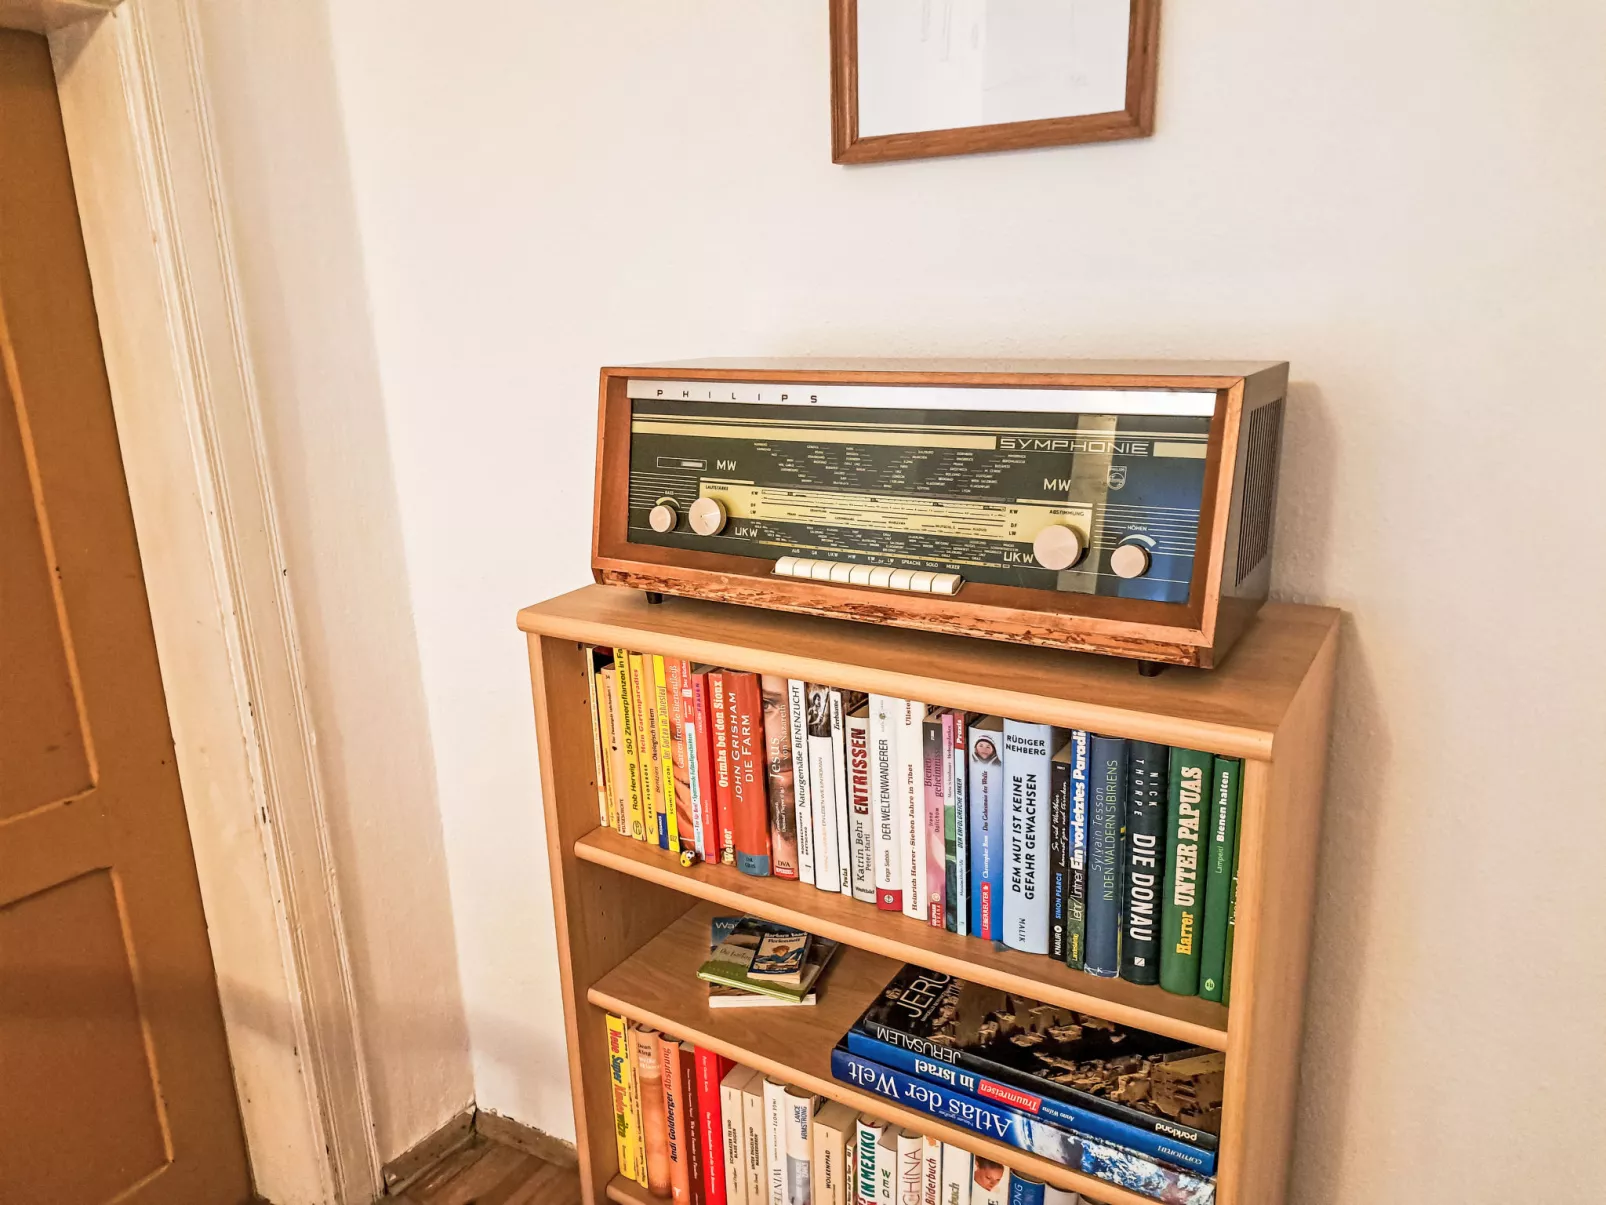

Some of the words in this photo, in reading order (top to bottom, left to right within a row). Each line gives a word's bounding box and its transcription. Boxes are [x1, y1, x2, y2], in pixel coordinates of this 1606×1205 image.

[656, 389, 818, 404] PHILIPS
[1000, 438, 1149, 454] SYMPHONIE
[717, 459, 737, 471] MW
[1043, 478, 1071, 492] MW
[1049, 509, 1085, 517] ABSTIMMUNG
[1127, 523, 1148, 532] HÖHEN
[734, 526, 758, 538] UKW
[1003, 551, 1034, 564] UKW
[619, 670, 632, 736] Zimmerpflanzen
[633, 669, 645, 732] Gartenparadies
[713, 681, 723, 709] Sioux
[714, 712, 725, 730] den
[728, 692, 741, 761] GRISHAM
[778, 704, 787, 741] Nazareth
[791, 686, 802, 749] BIENENZUCHT
[671, 713, 685, 769] Gartenfreude
[716, 731, 726, 748] bei
[741, 714, 752, 756] FARM
[1005, 743, 1046, 756] NEHBERG
[1006, 735, 1045, 747] RÜDIGER
[768, 737, 785, 780] Jesus
[780, 744, 788, 761] von
[628, 763, 636, 792] Herwig
[732, 765, 743, 802] JOHN
[744, 760, 754, 782] DIE
[795, 750, 806, 808] Naturgemäße
[850, 728, 869, 815] ENTRISSEN
[878, 739, 890, 821] WELTENWANDERER
[906, 764, 914, 785] Tibet
[1105, 759, 1117, 813] SIBIRIENS
[1012, 775, 1022, 812] KEINE
[1133, 759, 1145, 816] THORPE
[1148, 772, 1158, 807] NICK
[1218, 771, 1230, 806] halten
[907, 795, 915, 818] Jahre
[1025, 773, 1037, 850] GEWACHSEN
[1072, 781, 1085, 848] vorletztes
[1092, 787, 1103, 826] Tesson
[1176, 766, 1203, 842] PAPUAS
[854, 820, 864, 846] Behr
[881, 823, 892, 841] DER
[908, 820, 916, 847] Sieben
[1012, 814, 1022, 834] IST
[1215, 806, 1226, 843] Bienen
[722, 828, 733, 863] Weiser
[1012, 837, 1022, 864] MUT
[1070, 849, 1084, 870] Ein
[1091, 829, 1103, 871] Sylvain
[1131, 832, 1156, 867] DIE
[856, 848, 865, 882] Katrin
[862, 852, 871, 872] Peter
[909, 850, 917, 877] Harrer
[1024, 853, 1036, 900] GEFAHR
[1103, 867, 1115, 888] DEN
[1173, 843, 1197, 907] UNTER
[910, 878, 918, 911] Heinrich
[1012, 867, 1022, 893] DEM
[1103, 889, 1114, 901] IN
[1129, 871, 1154, 941] DONAU
[1018, 917, 1026, 942] MALIK
[1176, 911, 1194, 955] Harrer
[609, 1028, 622, 1054] Neue
[876, 1026, 961, 1064] JERUSALEM
[611, 1055, 624, 1084] Super
[662, 1048, 672, 1091] Absprung
[846, 1060, 900, 1099] Welt
[913, 1058, 957, 1086] Israel
[959, 1074, 975, 1092] in
[613, 1082, 629, 1138] Kinderwitze
[903, 1084, 943, 1112] der
[980, 1082, 1037, 1112] Traumreisen
[665, 1092, 676, 1140] Goldberger
[800, 1106, 808, 1141] ARMSTRONG
[948, 1097, 1013, 1138] Atlas
[1154, 1122, 1198, 1141] parkland
[669, 1143, 678, 1163] Andi
[860, 1130, 875, 1182] MEXIKO
[860, 1181, 875, 1198] IN
